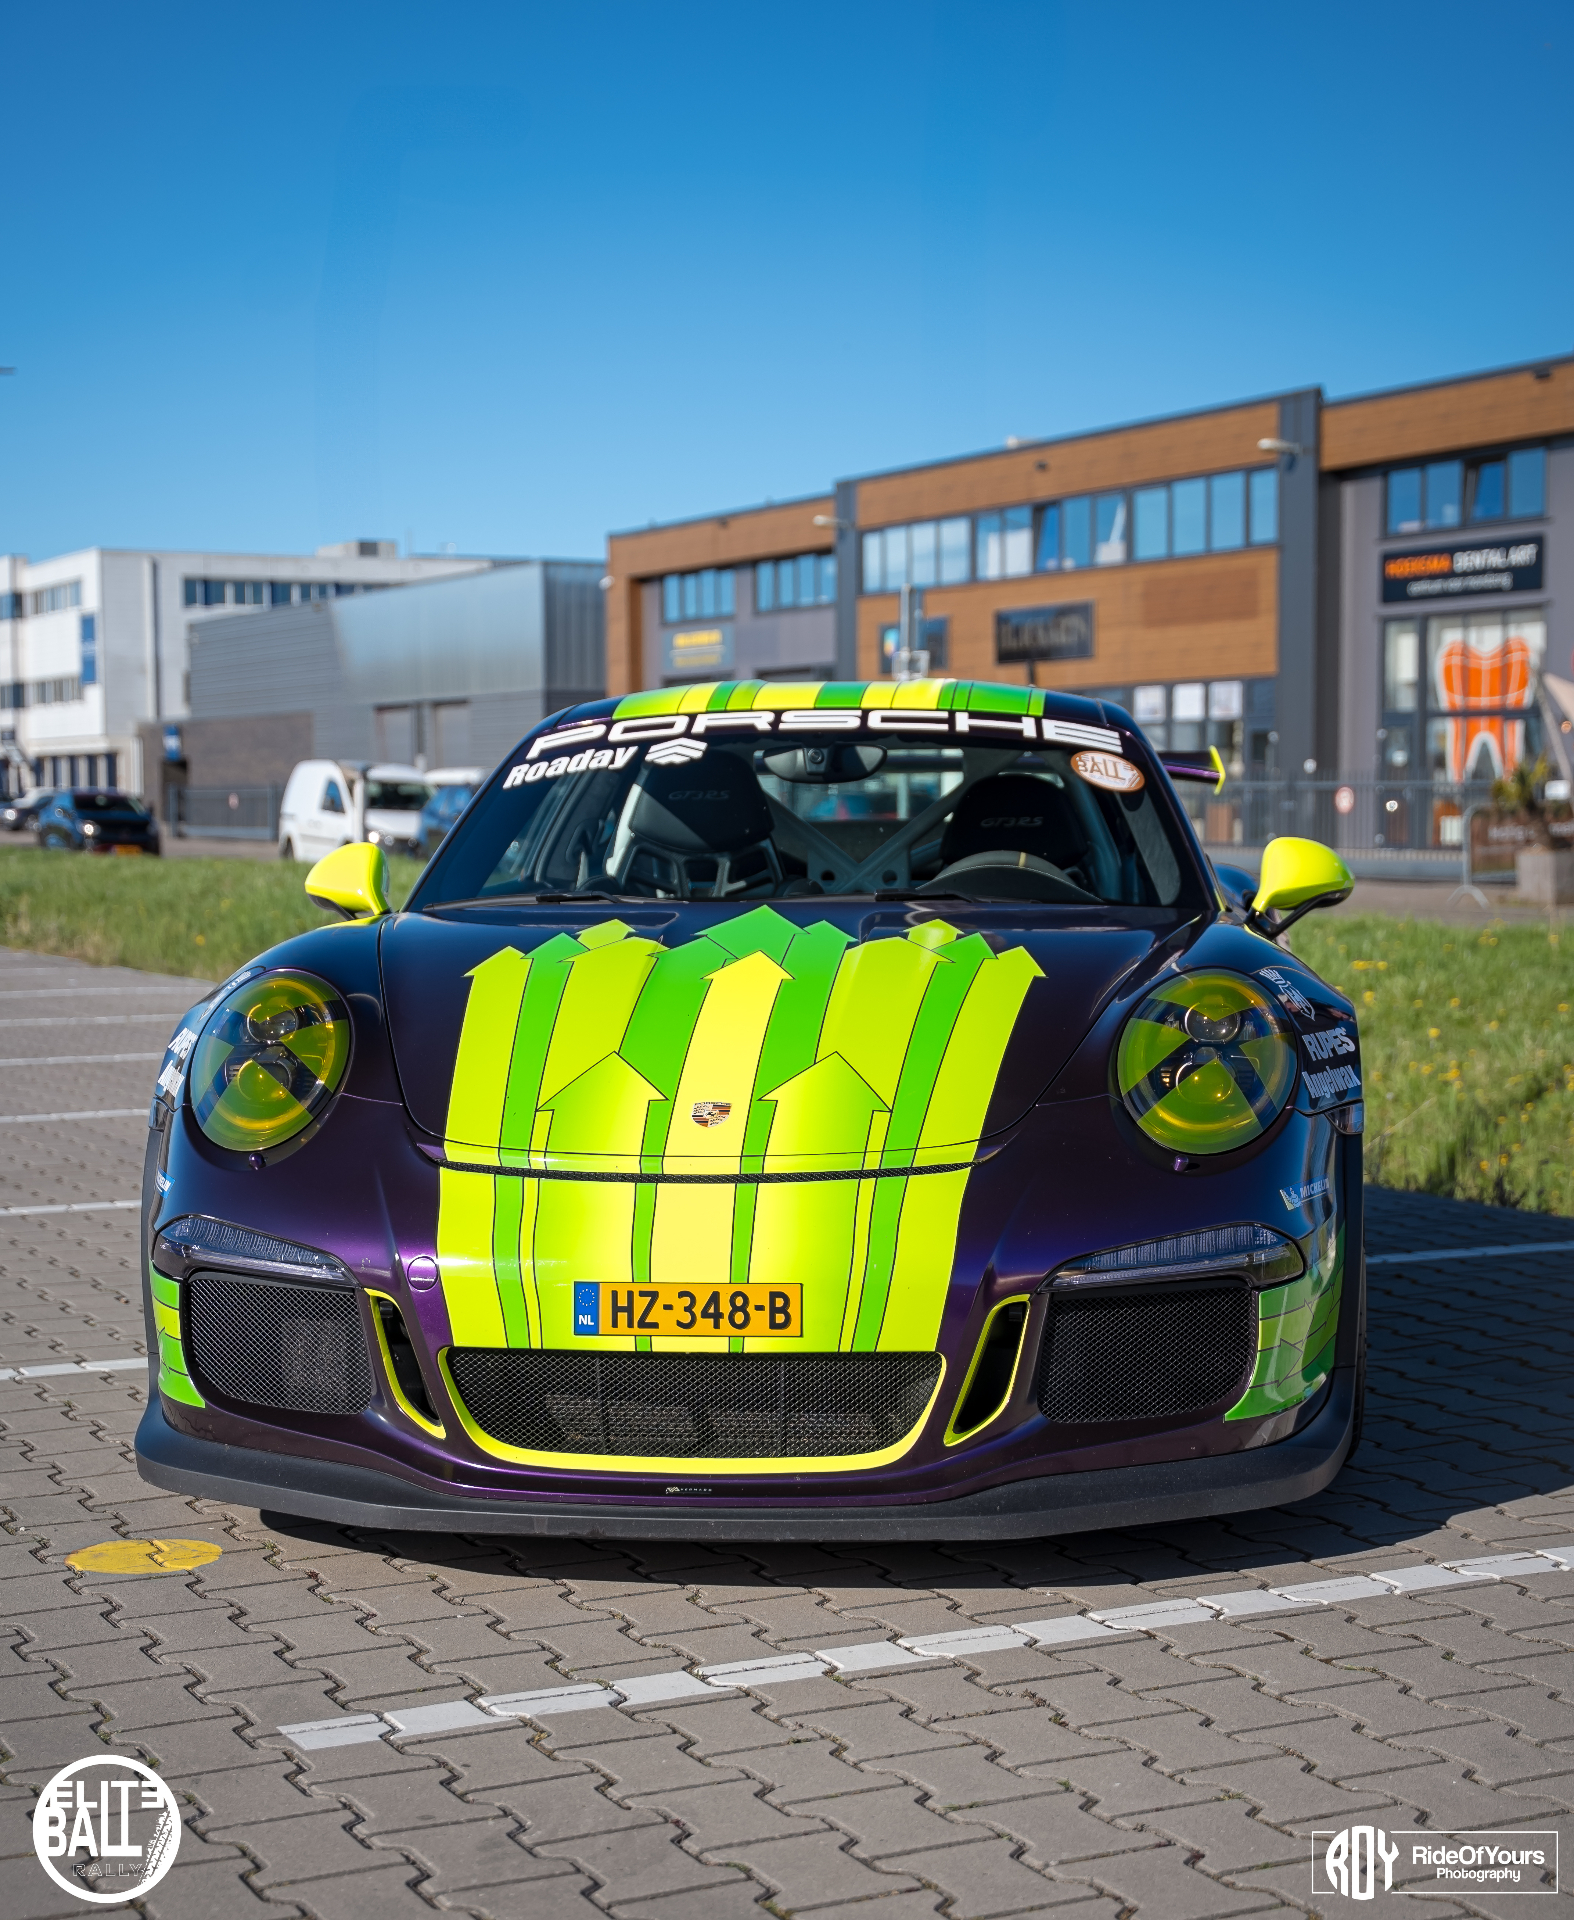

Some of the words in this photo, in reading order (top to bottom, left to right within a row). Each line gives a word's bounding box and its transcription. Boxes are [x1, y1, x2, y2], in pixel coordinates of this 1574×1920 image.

[525, 710, 1123, 760] PORSCHE
[502, 745, 639, 790] Roaday
[1301, 1027, 1356, 1062] RUPES
[578, 1315, 595, 1326] NL
[610, 1290, 792, 1331] HZ-348-B
